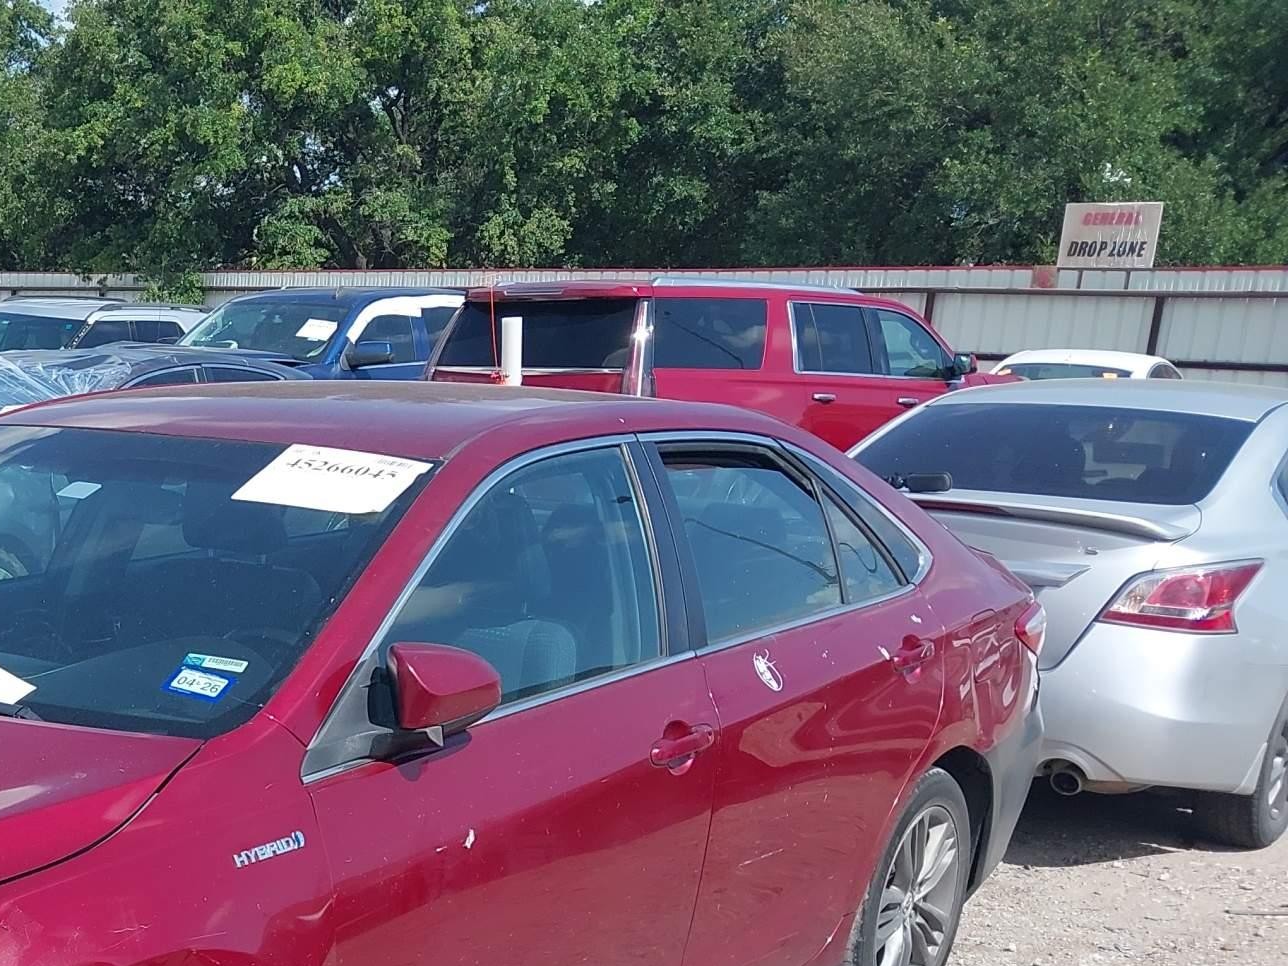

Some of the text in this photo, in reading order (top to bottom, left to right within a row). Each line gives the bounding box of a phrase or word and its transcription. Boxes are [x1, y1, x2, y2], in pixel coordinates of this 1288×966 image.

[1067, 240, 1148, 258] DROP ZONE
[285, 457, 399, 480] 45266045
[233, 837, 295, 868] HYBRID
